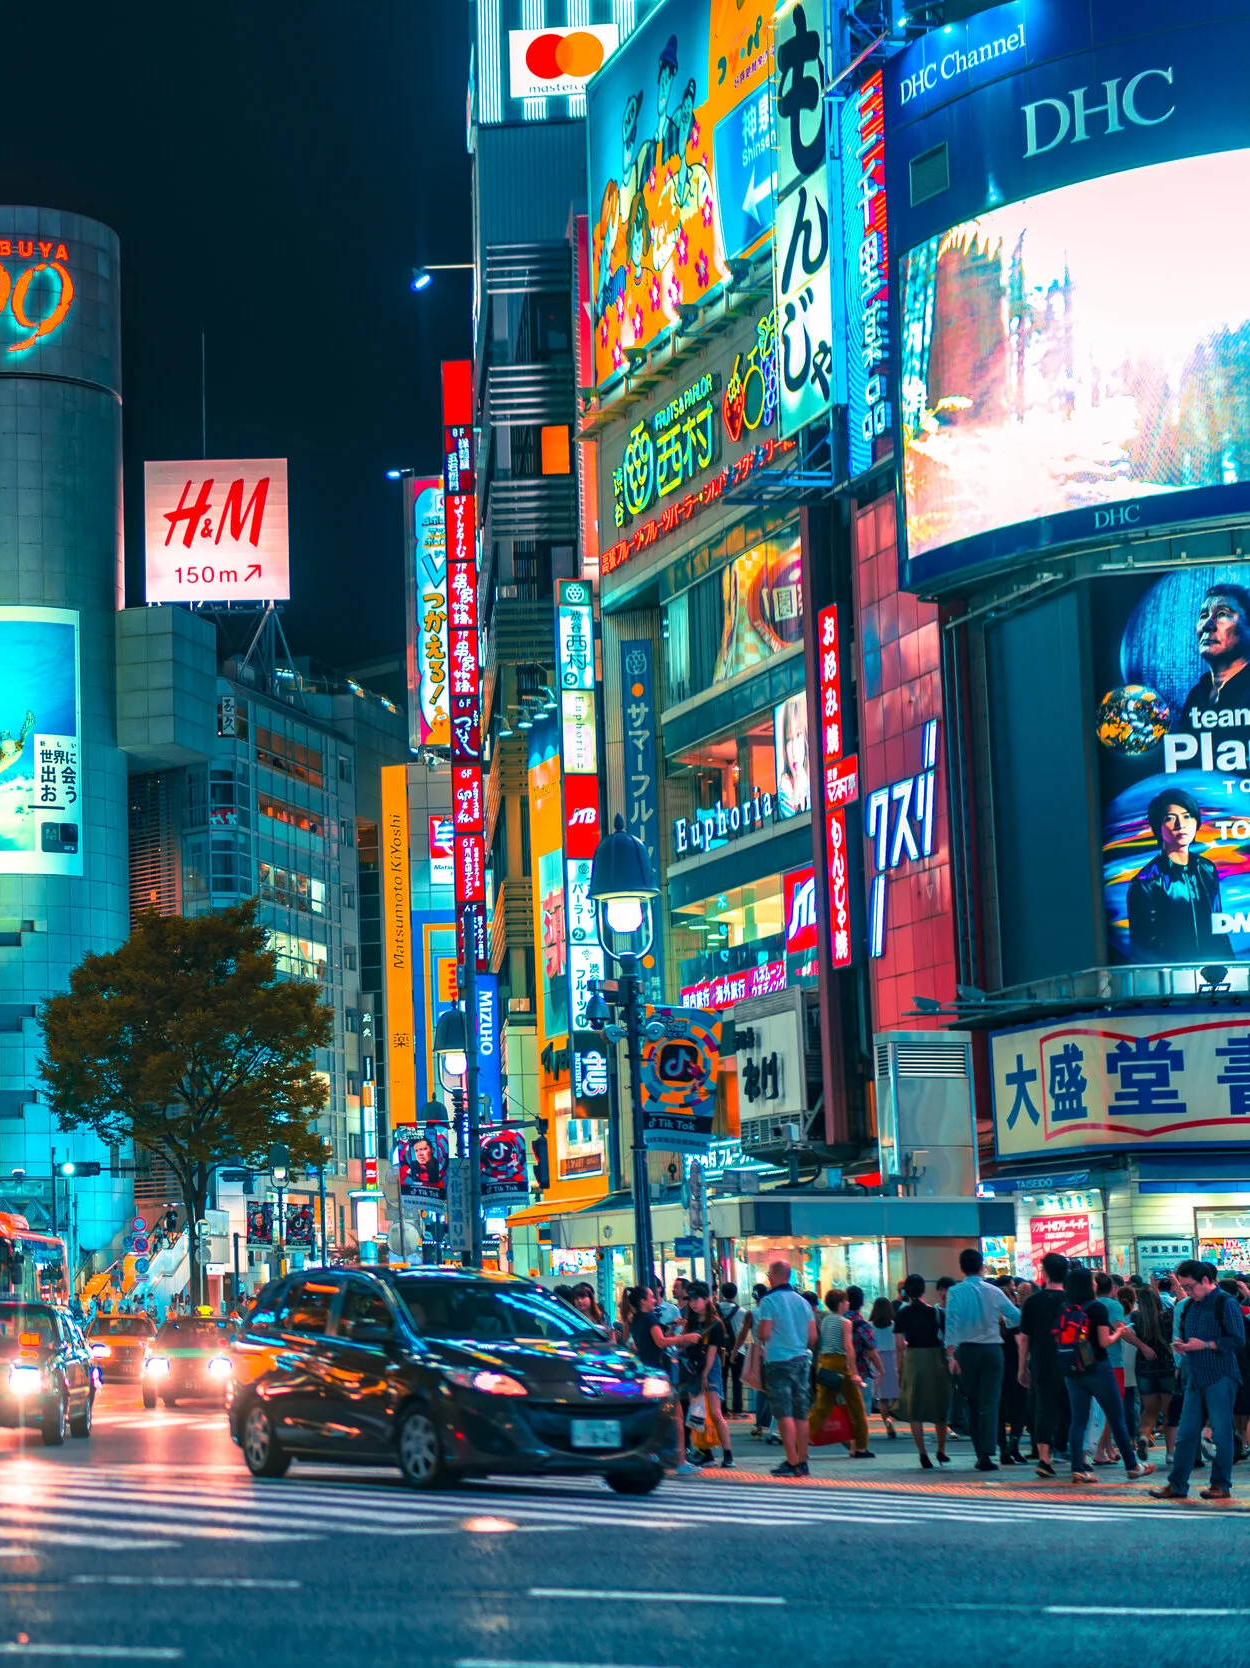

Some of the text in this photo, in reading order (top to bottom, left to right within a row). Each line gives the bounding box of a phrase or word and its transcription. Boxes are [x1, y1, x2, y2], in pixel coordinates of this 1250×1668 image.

[900, 24, 1026, 106] DHC Channel
[1021, 66, 1175, 159] DHC
[778, 3, 833, 401] もんじゃ
[163, 477, 270, 548] H&M
[1094, 504, 1141, 530] DHC
[456, 563, 468, 572] 7F
[457, 631, 469, 640] 7F
[458, 699, 472, 708] 6F
[574, 696, 584, 760] Euphoria
[40, 740, 77, 749] 新しい
[40, 749, 78, 765] 世界に
[1163, 732, 1250, 774] Pla
[41, 766, 78, 784] 出会
[460, 769, 473, 778] 6F
[627, 703, 655, 858] サマーフルー
[41, 785, 78, 804] おう
[569, 807, 597, 826] JTB
[675, 786, 773, 852] Euphoria
[462, 838, 475, 847] 6F
[572, 884, 584, 925] パーラー
[391, 876, 405, 969] Matsumoto
[575, 970, 588, 1011] フルーツ
[715, 979, 746, 1004] 海外旅行
[479, 990, 493, 1056] MIZUHO
[582, 1050, 608, 1097] HUB
[658, 1117, 695, 1131] Tik Tok
[1015, 1178, 1053, 1189] TAISEIDO
